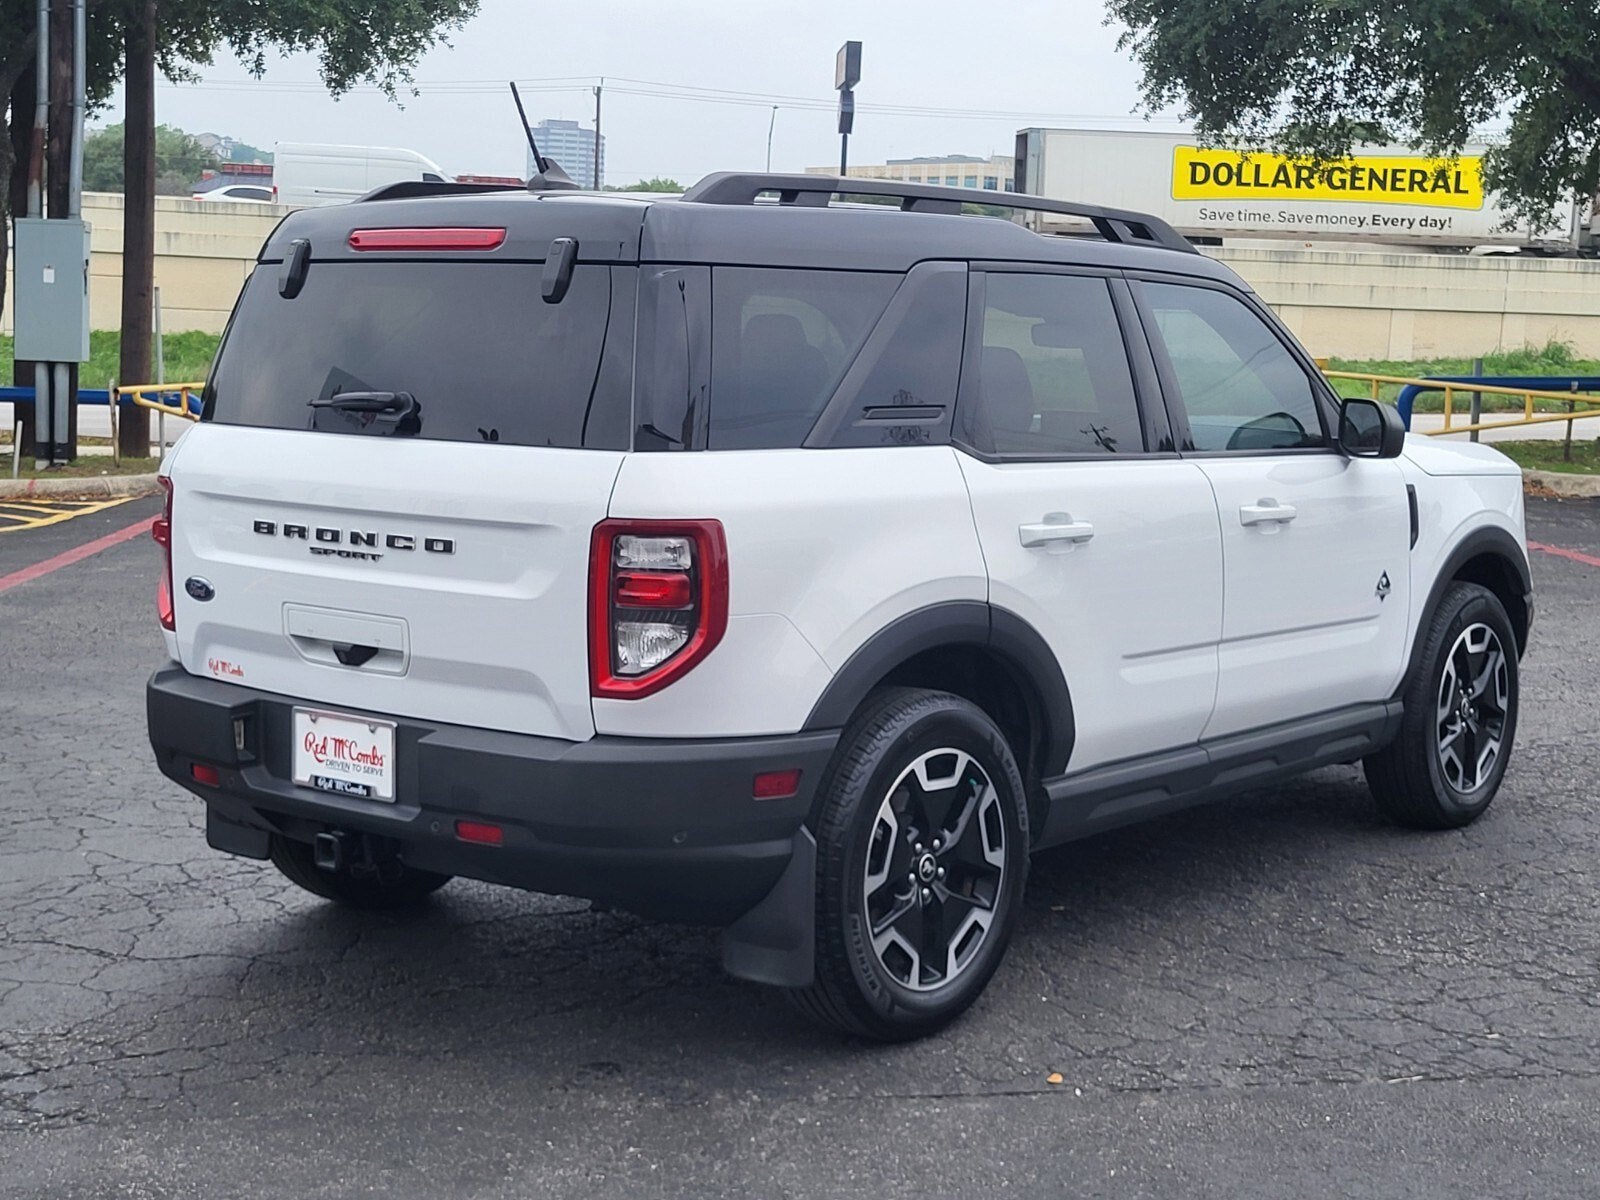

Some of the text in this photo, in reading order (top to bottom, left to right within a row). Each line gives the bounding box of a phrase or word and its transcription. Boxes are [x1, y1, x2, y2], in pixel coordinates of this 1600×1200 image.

[1189, 161, 1470, 195] DOLLAR GENERAL
[1198, 208, 1453, 230] Save time. Save money. Every day!
[253, 519, 456, 555] BRONCO
[309, 546, 384, 563] SPORT
[304, 731, 328, 763] Red
[325, 758, 384, 776] DRIVEN TO SERVE
[850, 917, 880, 991] MICHELIN
